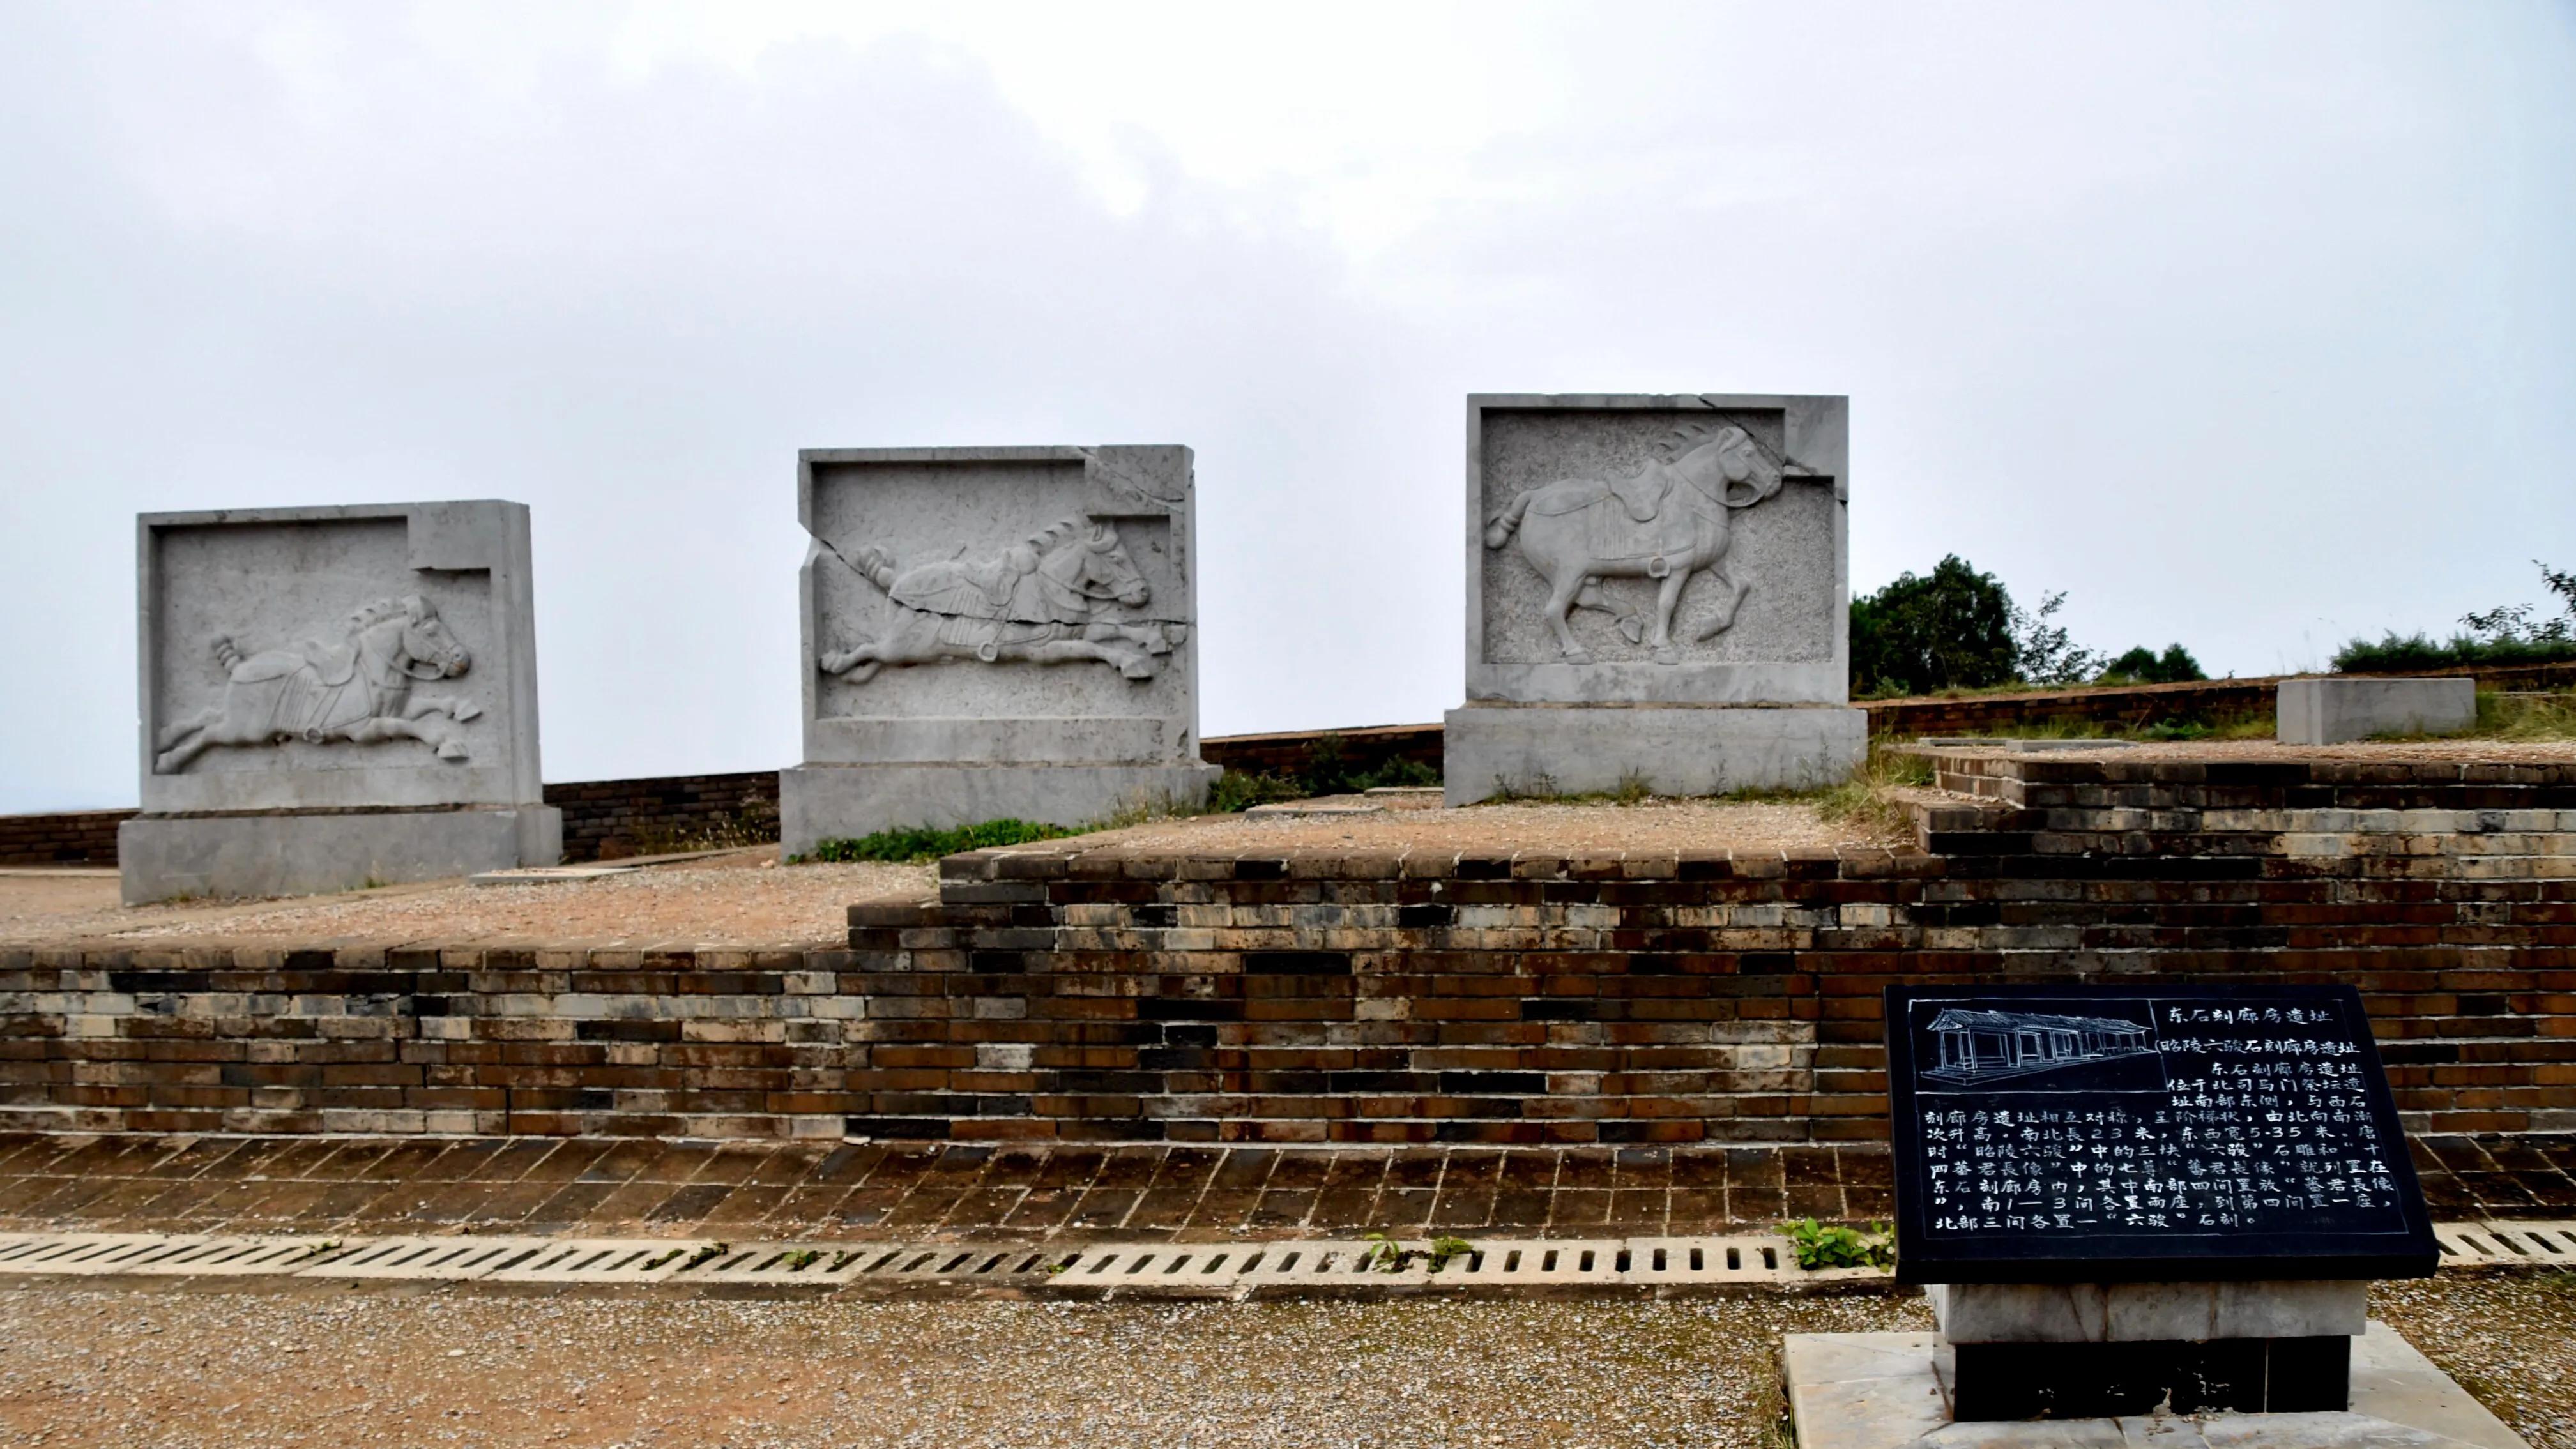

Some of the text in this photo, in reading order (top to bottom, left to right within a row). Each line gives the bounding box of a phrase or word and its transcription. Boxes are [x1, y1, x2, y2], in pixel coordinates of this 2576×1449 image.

[2169, 1006, 2334, 1025] 东石刻廊房遗址
[2211, 1061, 2363, 1077] 东石刻廊房遗址
